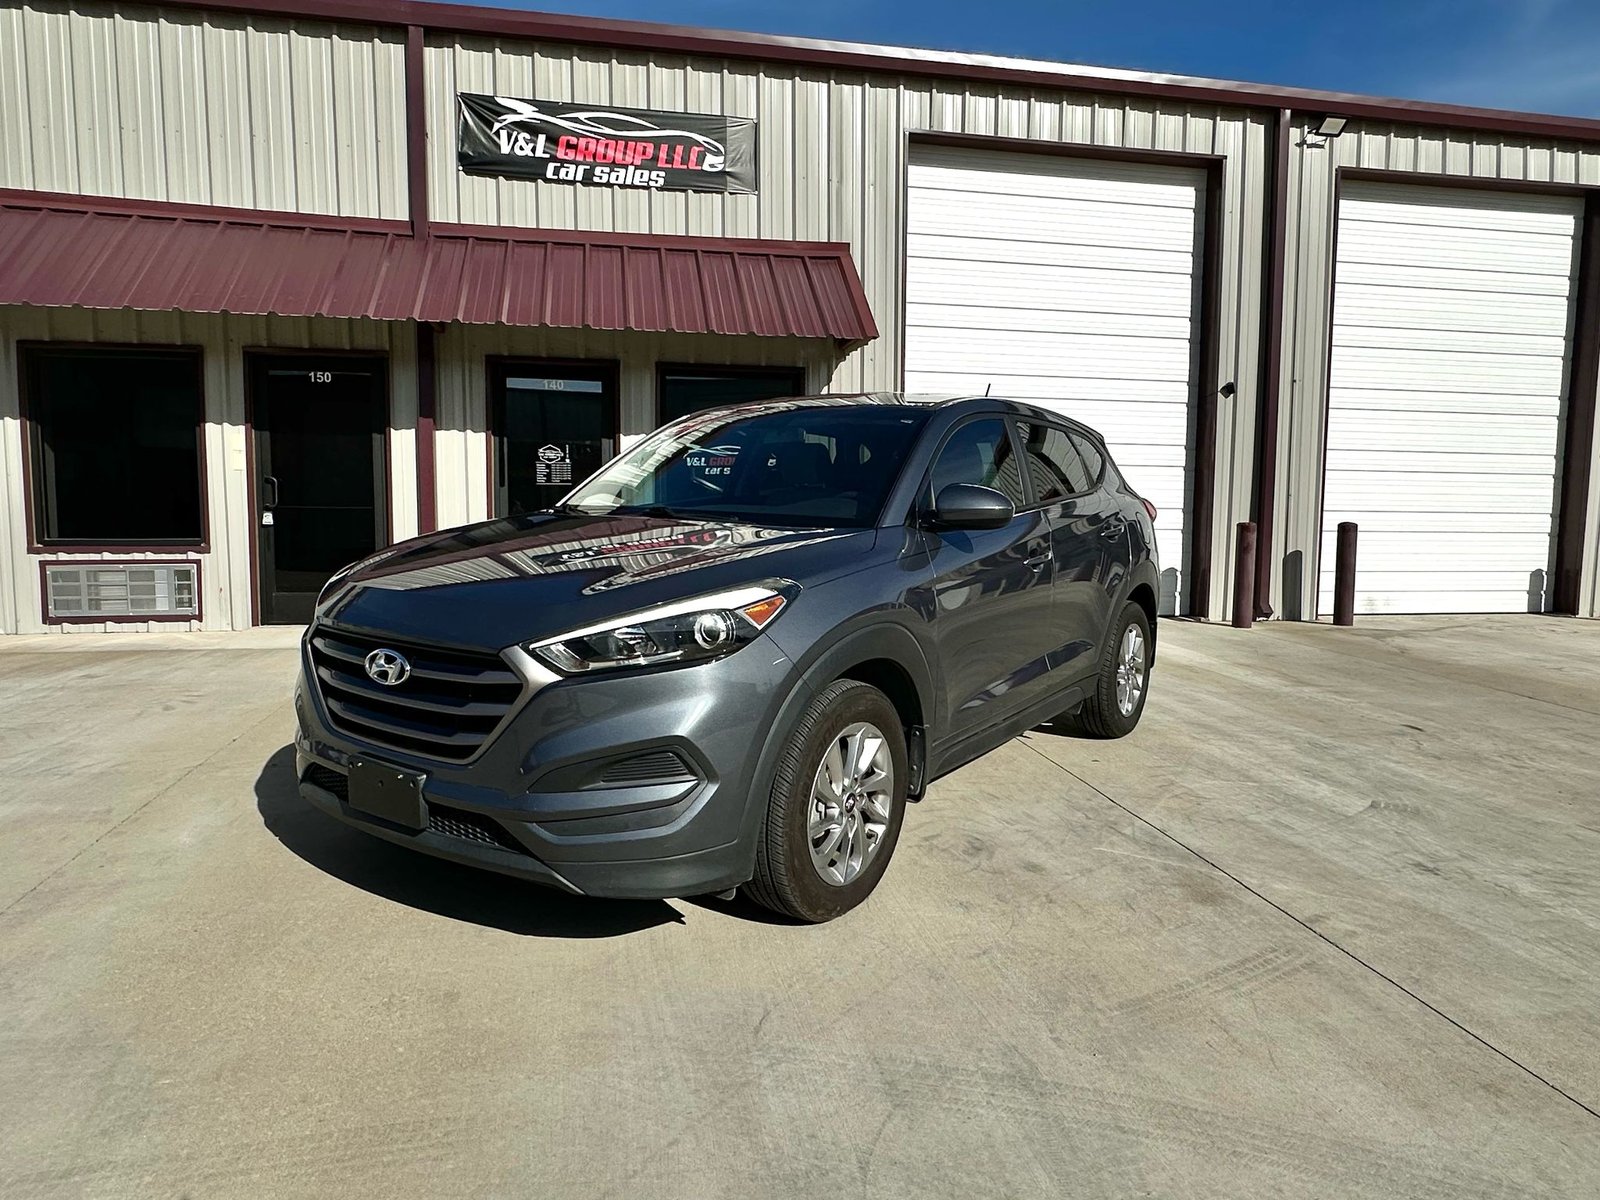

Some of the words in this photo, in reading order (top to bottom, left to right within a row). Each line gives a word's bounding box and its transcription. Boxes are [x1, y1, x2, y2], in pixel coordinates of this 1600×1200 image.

[500, 129, 550, 158] V&L
[557, 136, 654, 165] GROUP
[658, 145, 705, 170] LLC
[546, 162, 590, 182] car
[593, 167, 666, 187] sales
[308, 371, 332, 383] 150
[543, 379, 564, 391] 140
[686, 457, 707, 467] V&L
